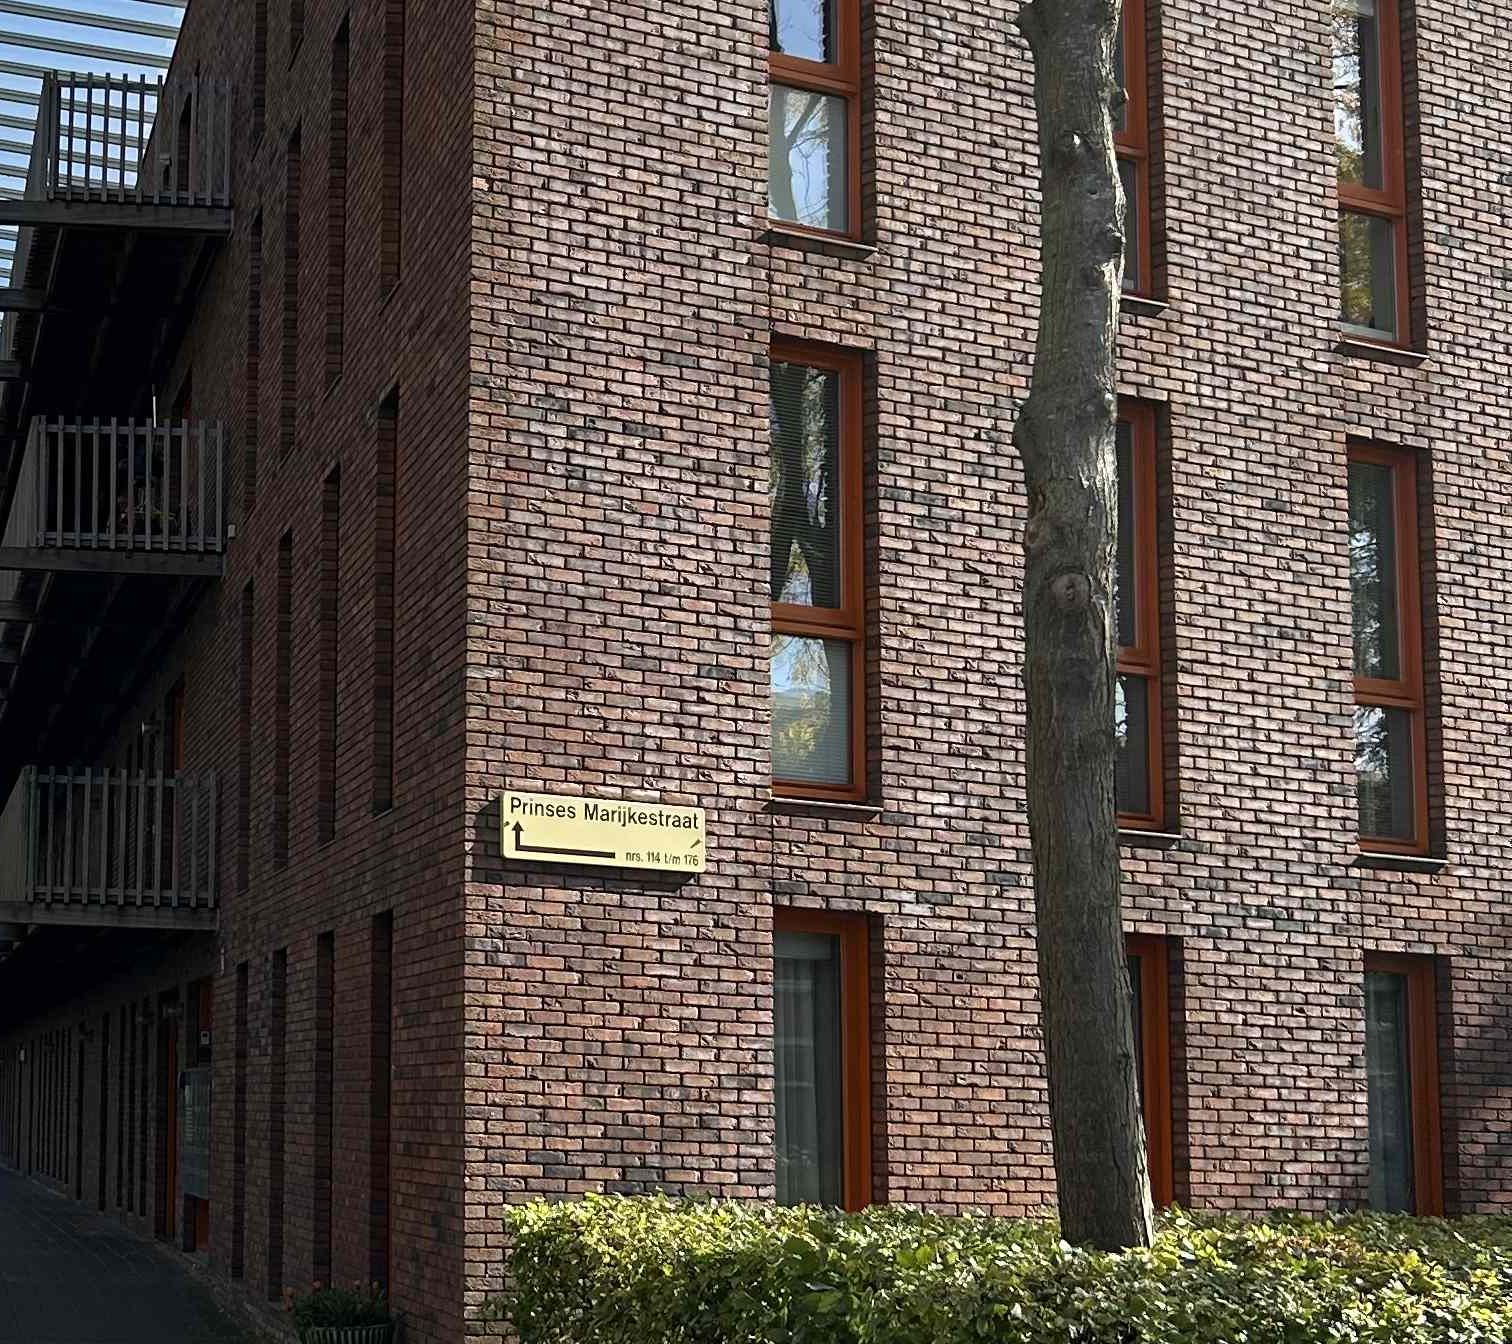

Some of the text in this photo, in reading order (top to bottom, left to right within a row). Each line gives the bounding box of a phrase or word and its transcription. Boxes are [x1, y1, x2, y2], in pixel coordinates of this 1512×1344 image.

[510, 796, 700, 830] Prinses Marijkestraat
[625, 850, 699, 867] nrs. 114 t/m 176
